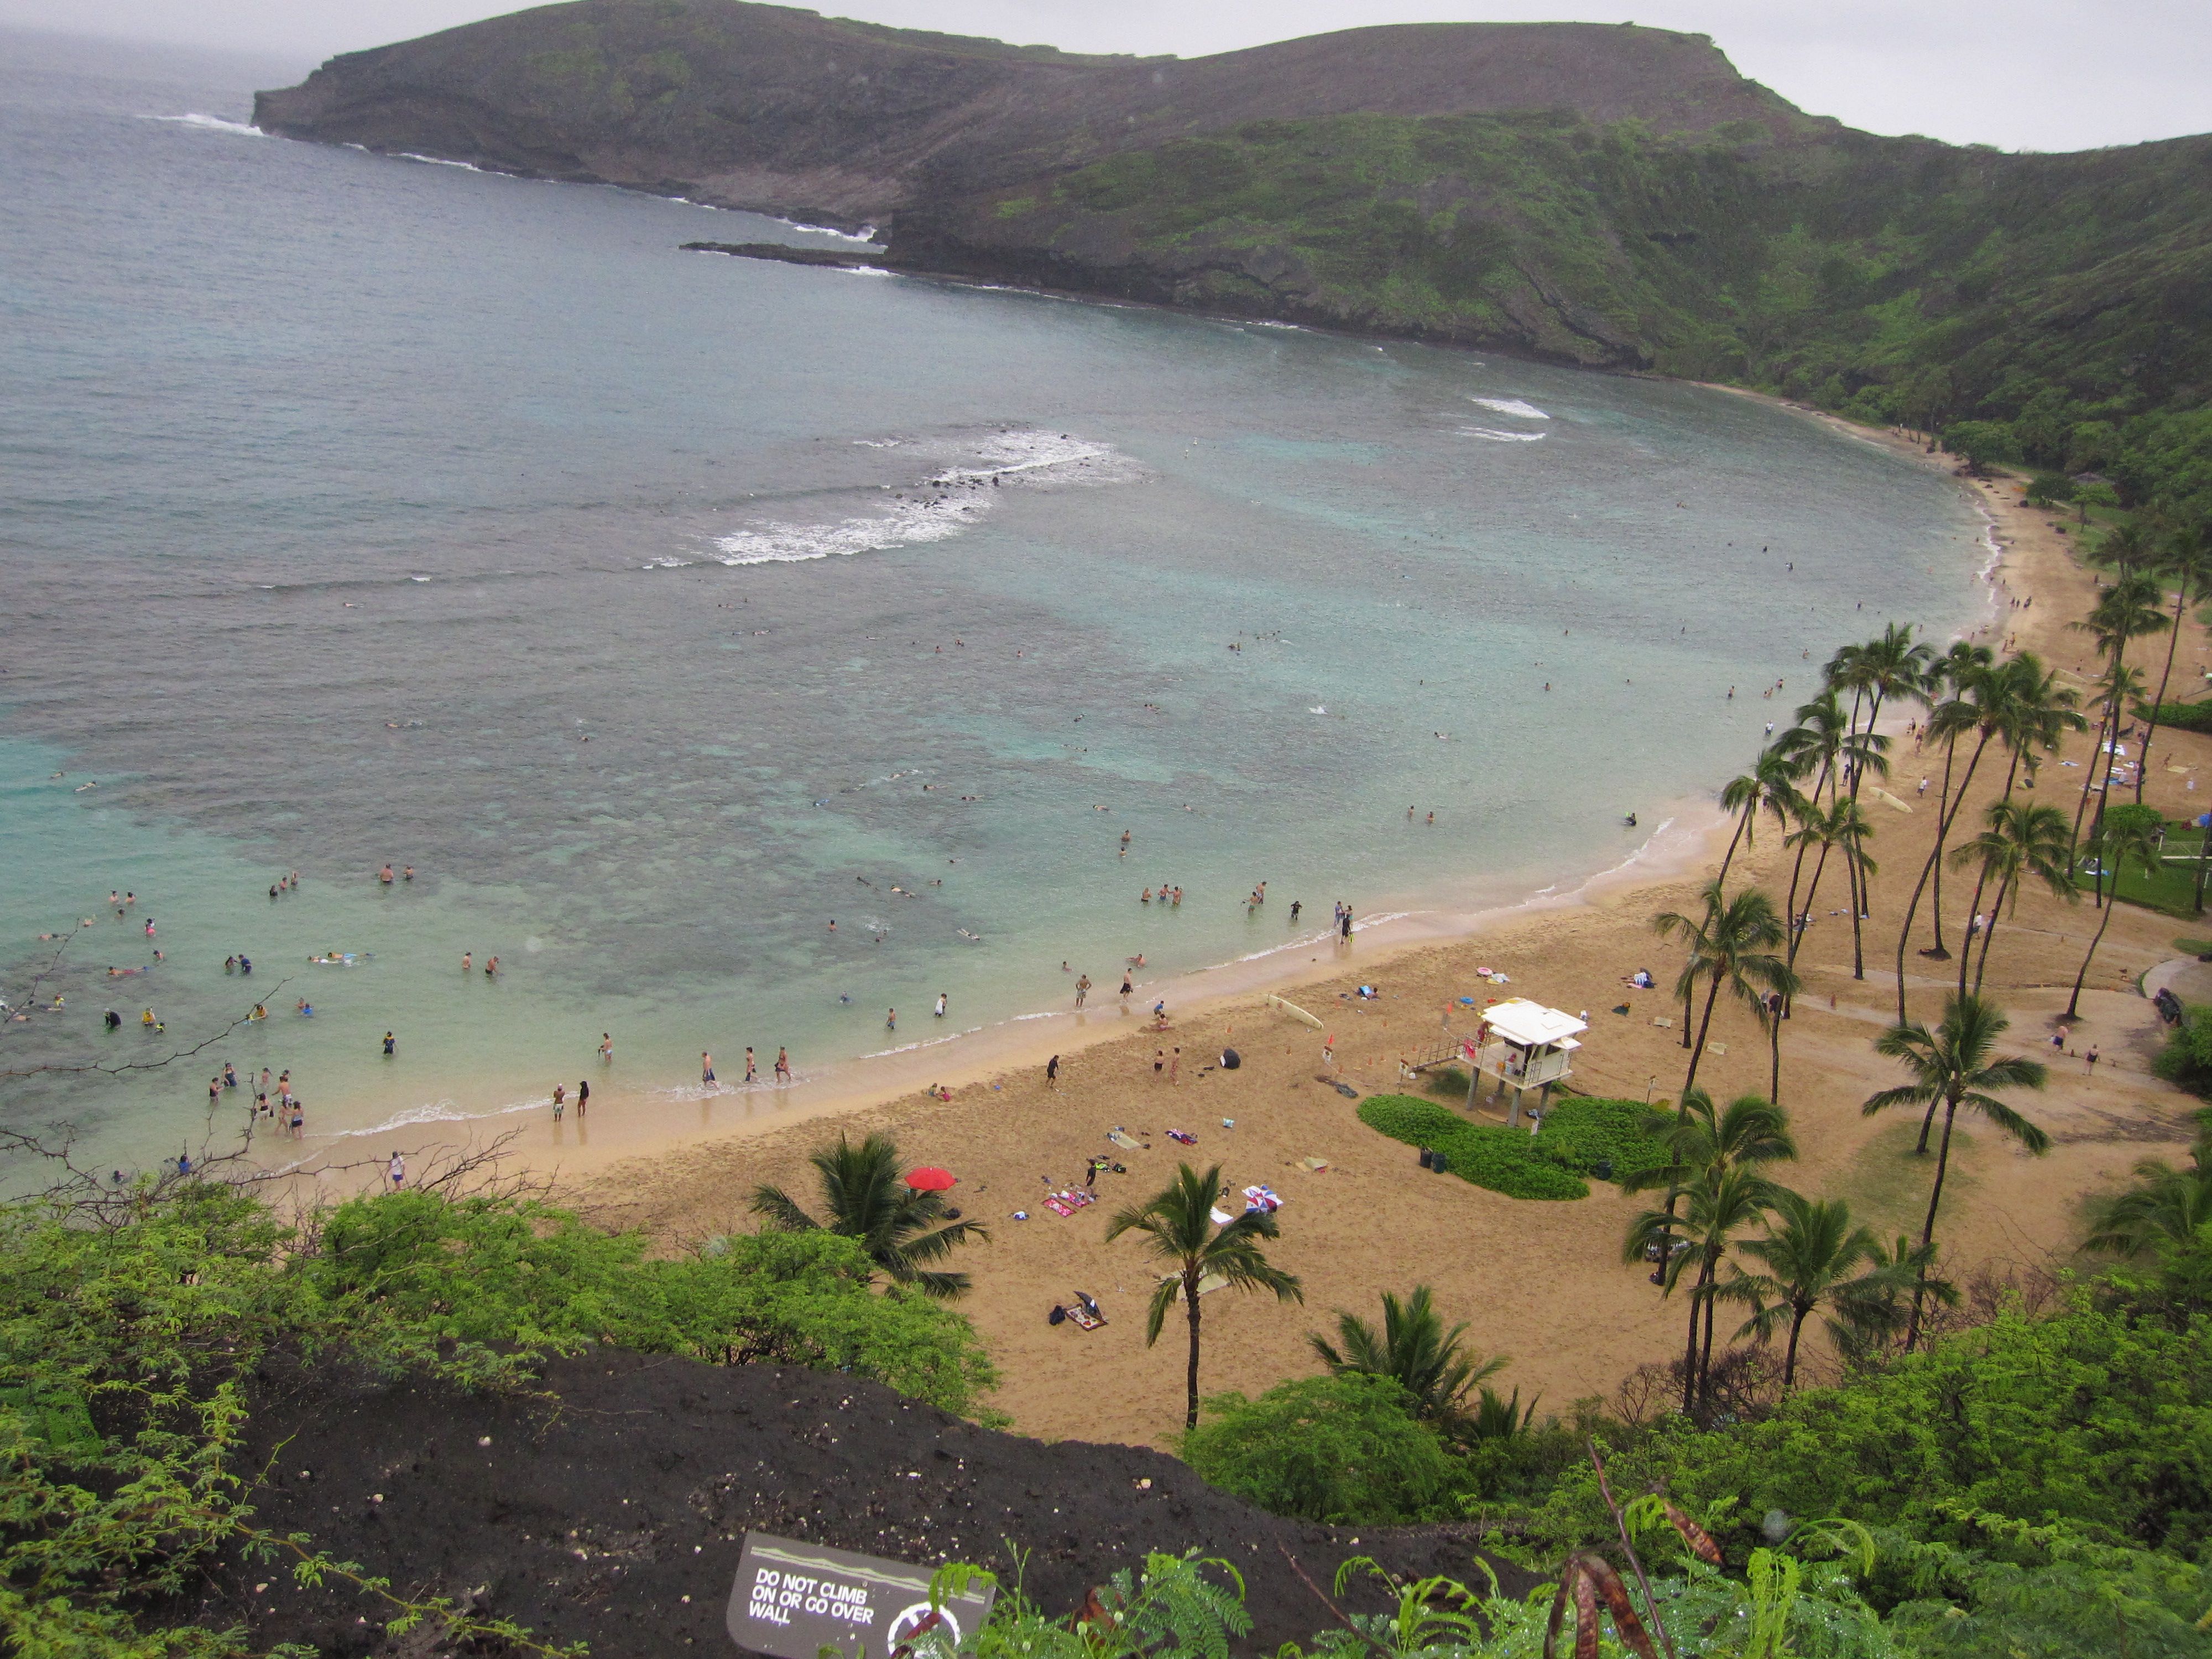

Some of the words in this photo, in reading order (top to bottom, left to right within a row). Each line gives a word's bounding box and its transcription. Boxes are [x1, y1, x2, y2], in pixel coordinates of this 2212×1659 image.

[752, 1584, 777, 1604] ON
[779, 1590, 802, 1609] OR
[805, 1596, 828, 1614] GO
[831, 1601, 874, 1625] OVER
[755, 1568, 780, 1587] DO
[782, 1574, 818, 1594] NOT
[820, 1582, 868, 1605] CLIMB
[749, 1600, 791, 1625] WALL
